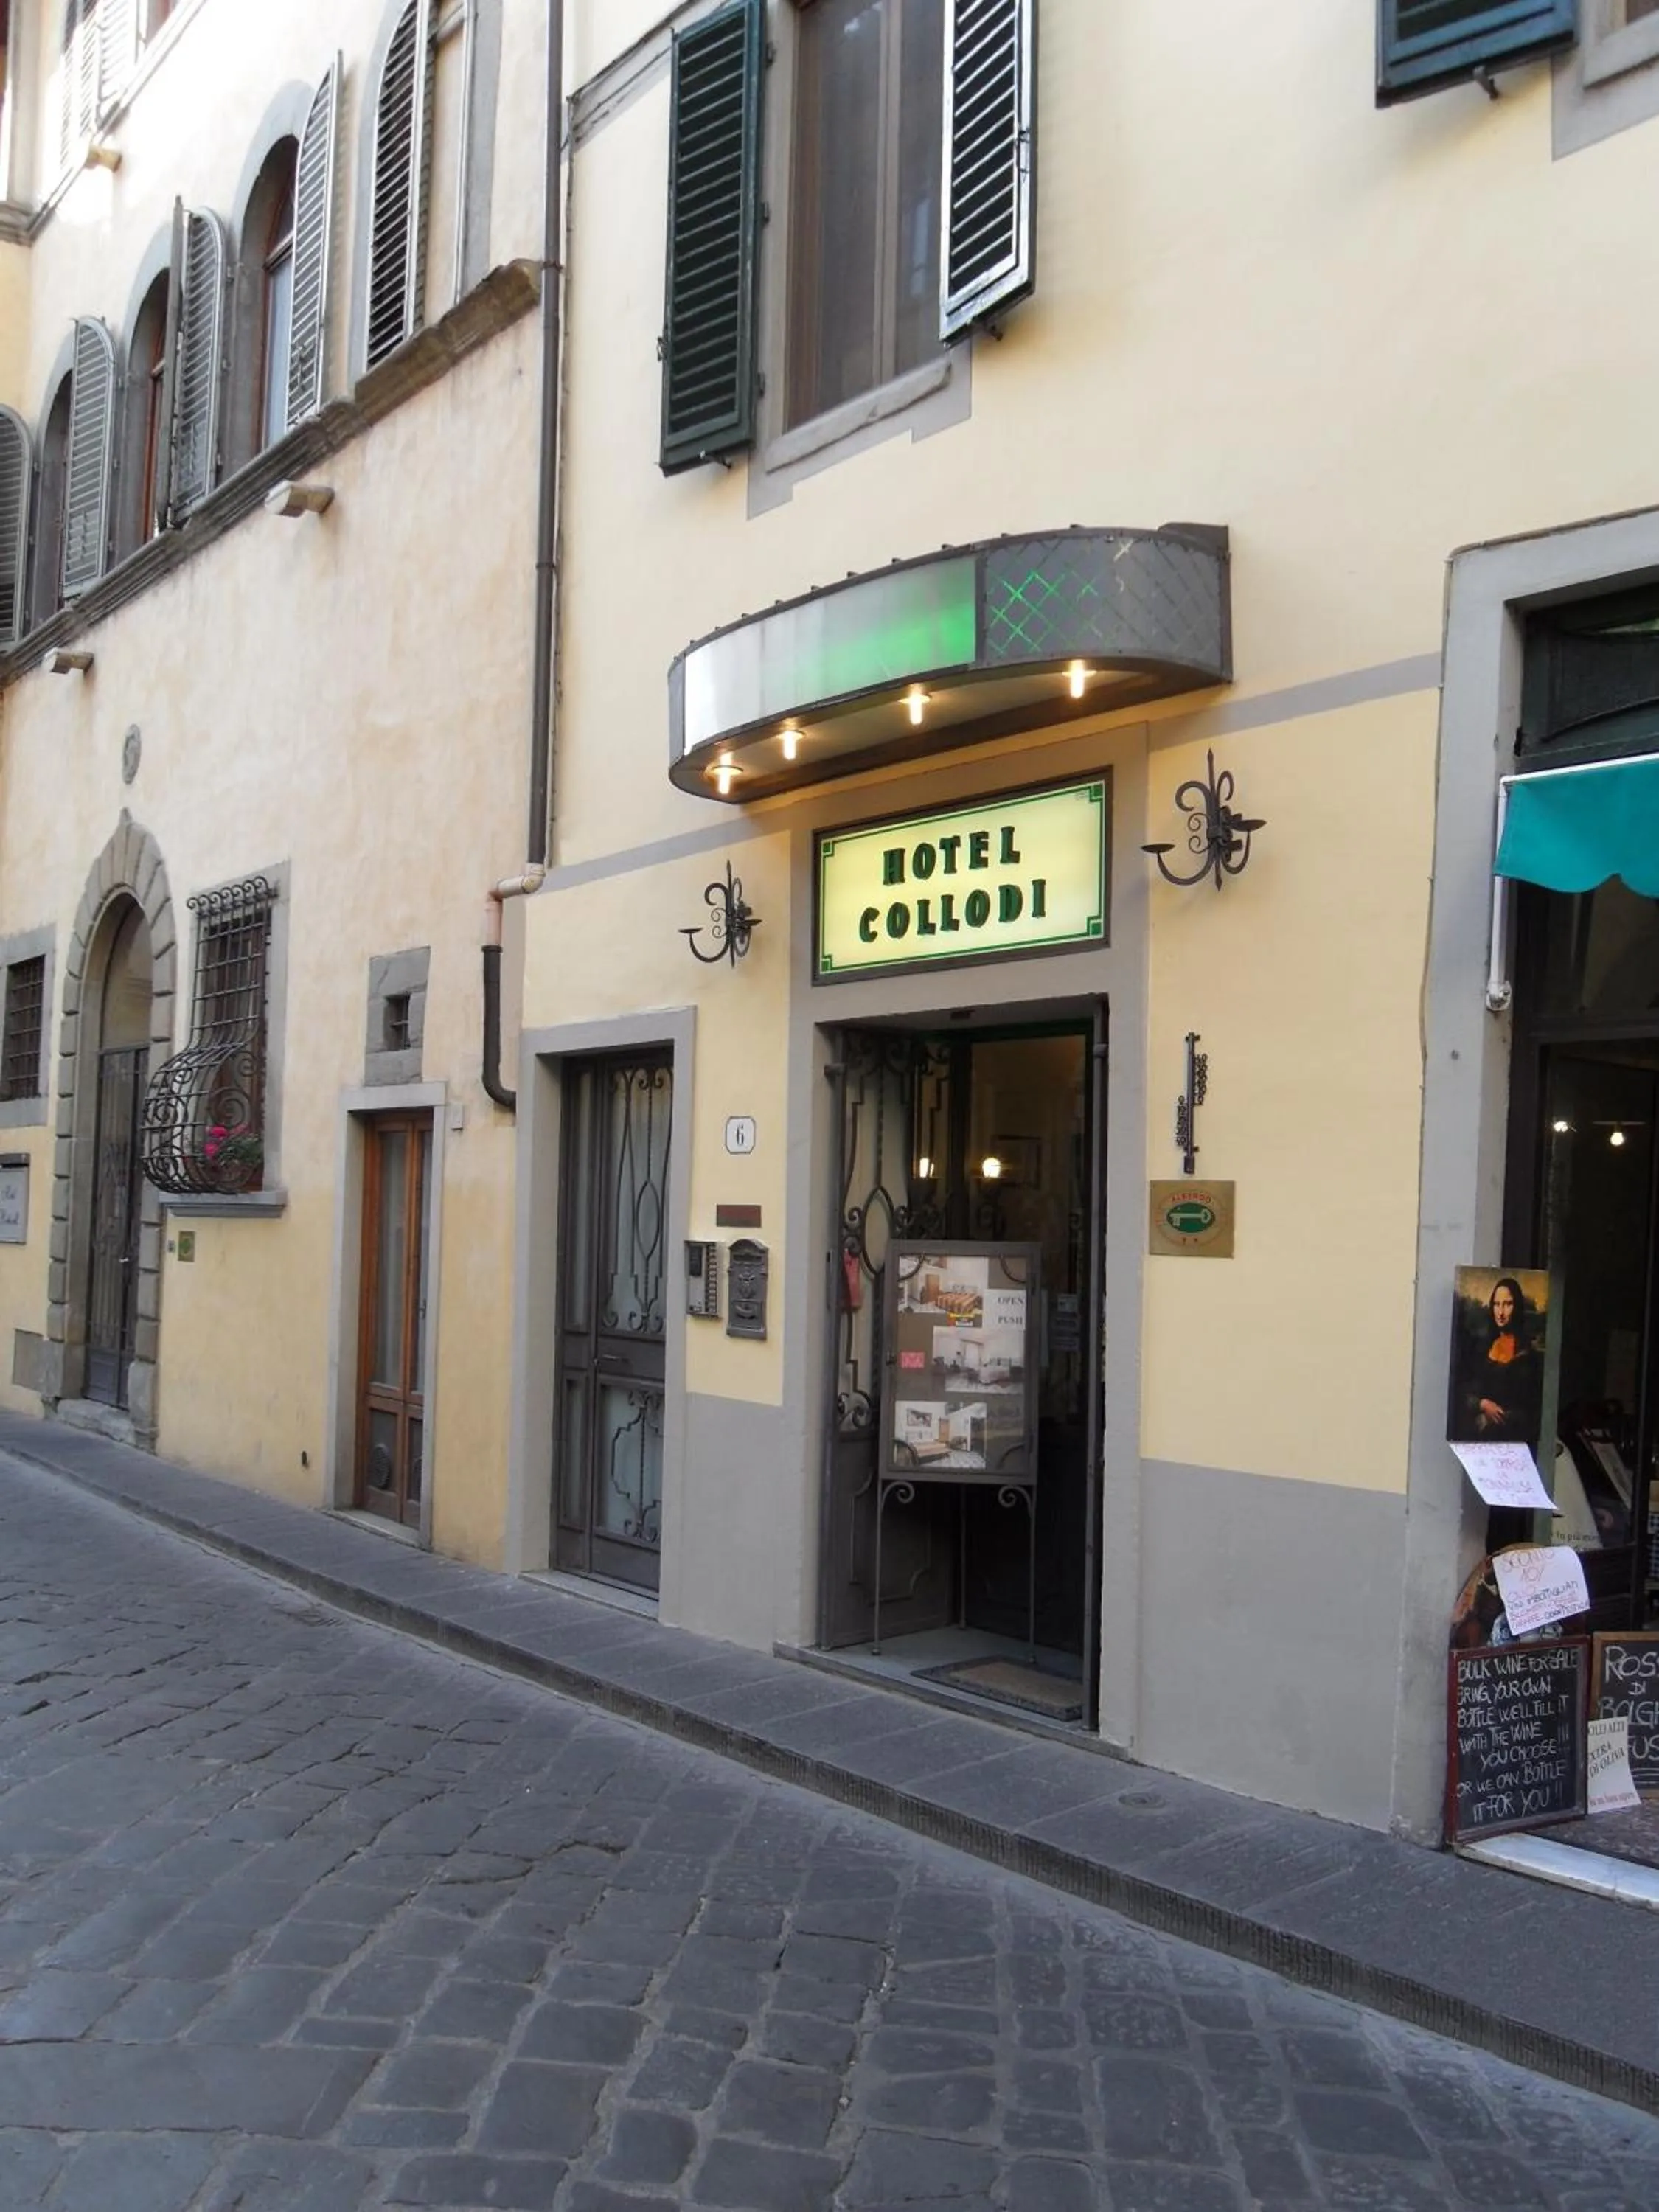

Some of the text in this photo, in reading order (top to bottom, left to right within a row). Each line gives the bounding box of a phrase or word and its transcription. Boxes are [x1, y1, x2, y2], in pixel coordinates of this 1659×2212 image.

[883, 826, 1021, 886] HOTEL
[859, 879, 1046, 942] COLLODI
[736, 1123, 745, 1146] 6
[998, 1296, 1024, 1305] OPEN
[998, 1315, 1023, 1325] PUSH
[1458, 1649, 1579, 1683] BULK WINE FOR SALE
[1605, 1645, 1659, 1683] ROS
[1458, 1676, 1551, 1705] BRING YOUR OWN
[1628, 1680, 1646, 1696] DI
[1457, 1706, 1495, 1728] BOTTLE
[1558, 1695, 1569, 1711] IT
[1458, 1722, 1543, 1755] WITH THE WINE
[1481, 1749, 1508, 1771] YOU
[1510, 1739, 1557, 1761] CHOOSE
[1456, 1760, 1566, 1798] OR WE CAN BOTTLE
[1473, 1802, 1486, 1823] IT
[1487, 1791, 1515, 1818] FOR
[1520, 1785, 1549, 1817] YOU
